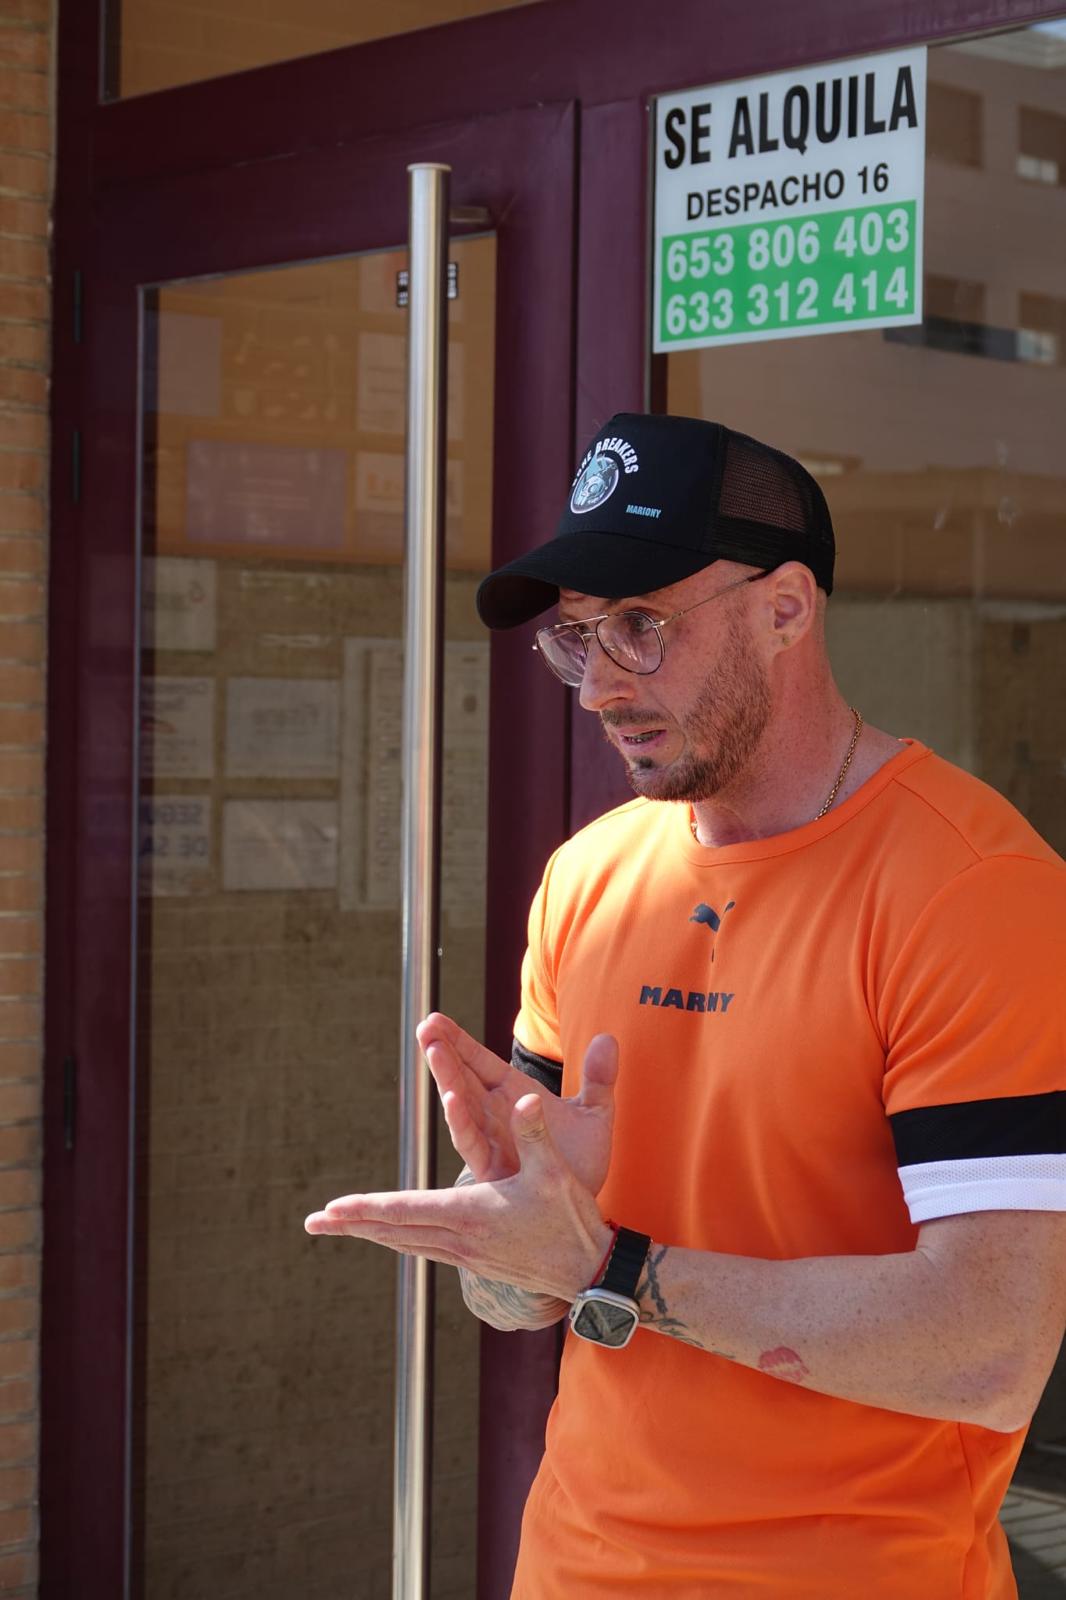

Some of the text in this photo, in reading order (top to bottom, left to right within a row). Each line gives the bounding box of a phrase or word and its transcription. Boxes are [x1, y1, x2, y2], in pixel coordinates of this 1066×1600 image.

[664, 65, 918, 170] SE ALQUILA
[687, 163, 889, 221] DESPACHO 16
[667, 208, 909, 282] 653 806 403
[666, 267, 908, 336] 633 312 414
[595, 437, 640, 474] BREAKERS
